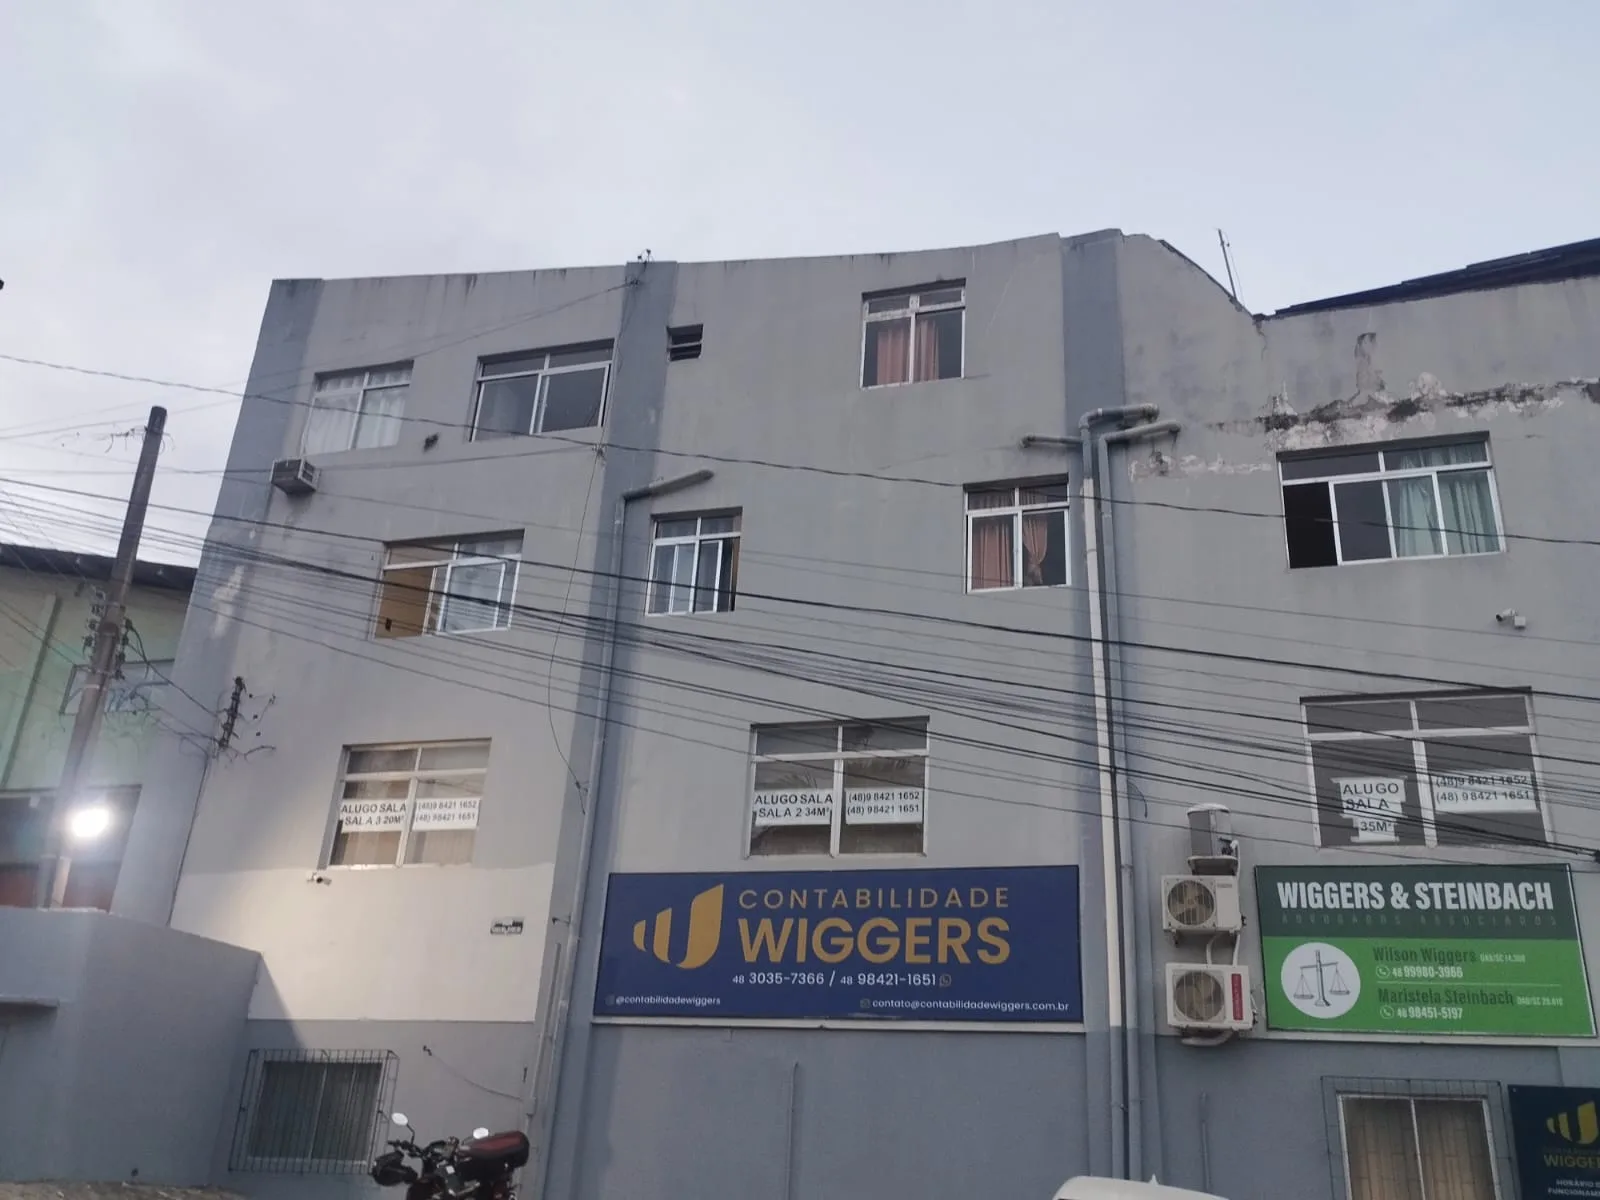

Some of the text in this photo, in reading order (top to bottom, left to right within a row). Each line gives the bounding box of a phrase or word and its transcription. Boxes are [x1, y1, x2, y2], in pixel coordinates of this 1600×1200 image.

[1343, 782, 1400, 795] ALUGO
[755, 793, 834, 805] ALUGO SALA
[873, 792, 896, 802] 8421
[898, 792, 920, 800] 1652
[1436, 792, 1459, 804] (48)
[341, 802, 407, 814] ALUGO SALA
[847, 806, 865, 816] (48)
[898, 804, 920, 814] 1651
[1345, 798, 1390, 810] SALA
[758, 808, 792, 818] SALA
[796, 808, 802, 817] 2
[344, 816, 373, 826] SALA
[739, 886, 1010, 910] CONTABILIDADE
[1276, 881, 1555, 911] WIGGERS & STEINBACH
[738, 916, 1011, 966] WIGGERS
[1373, 946, 1418, 962] Wilson
[1420, 947, 1477, 966] Wiggers
[732, 974, 746, 984] 48
[748, 972, 825, 985] 3035-7366
[840, 974, 854, 985] 48
[857, 972, 937, 986] 98421-1651
[1392, 967, 1403, 978] 48
[615, 994, 722, 1008] @contabilidadewiggers
[1378, 988, 1442, 1004] Maristela
[1445, 990, 1514, 1006] Steinbach
[872, 997, 1070, 1012] contato@contabilidadewiggers.com.br
[1396, 1006, 1464, 1020] 48 98451-5197
